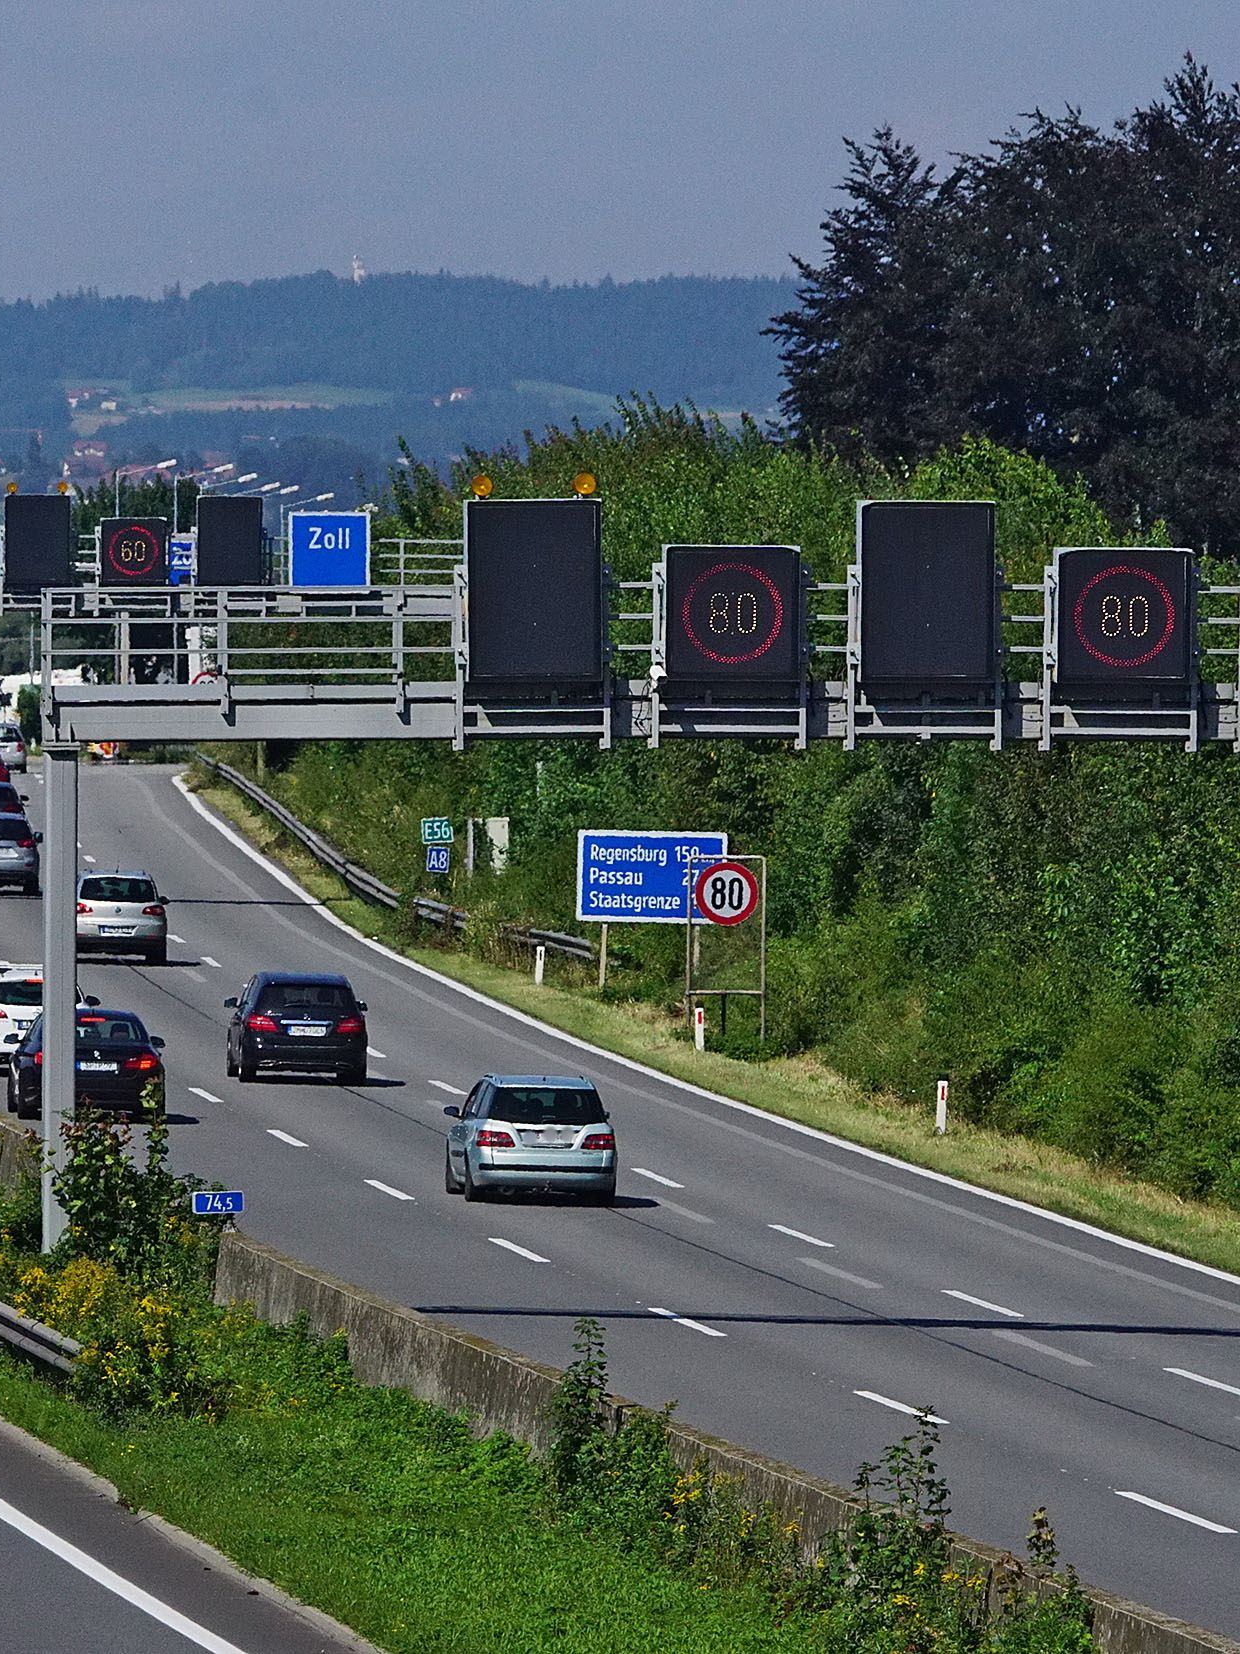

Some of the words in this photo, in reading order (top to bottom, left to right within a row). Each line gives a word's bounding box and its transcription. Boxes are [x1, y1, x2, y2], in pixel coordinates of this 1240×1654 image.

[308, 526, 350, 549] Zoll
[120, 540, 146, 561] 60
[709, 592, 757, 634] 80
[1101, 595, 1149, 637] 80
[424, 821, 451, 839] E56
[428, 850, 448, 869] A8
[590, 843, 668, 867] Regensburg
[674, 845, 700, 863] 150
[589, 866, 643, 885] Passau
[589, 890, 681, 913] Staatsgrenze
[711, 876, 744, 911] 80
[204, 1194, 234, 1212] 74,5
